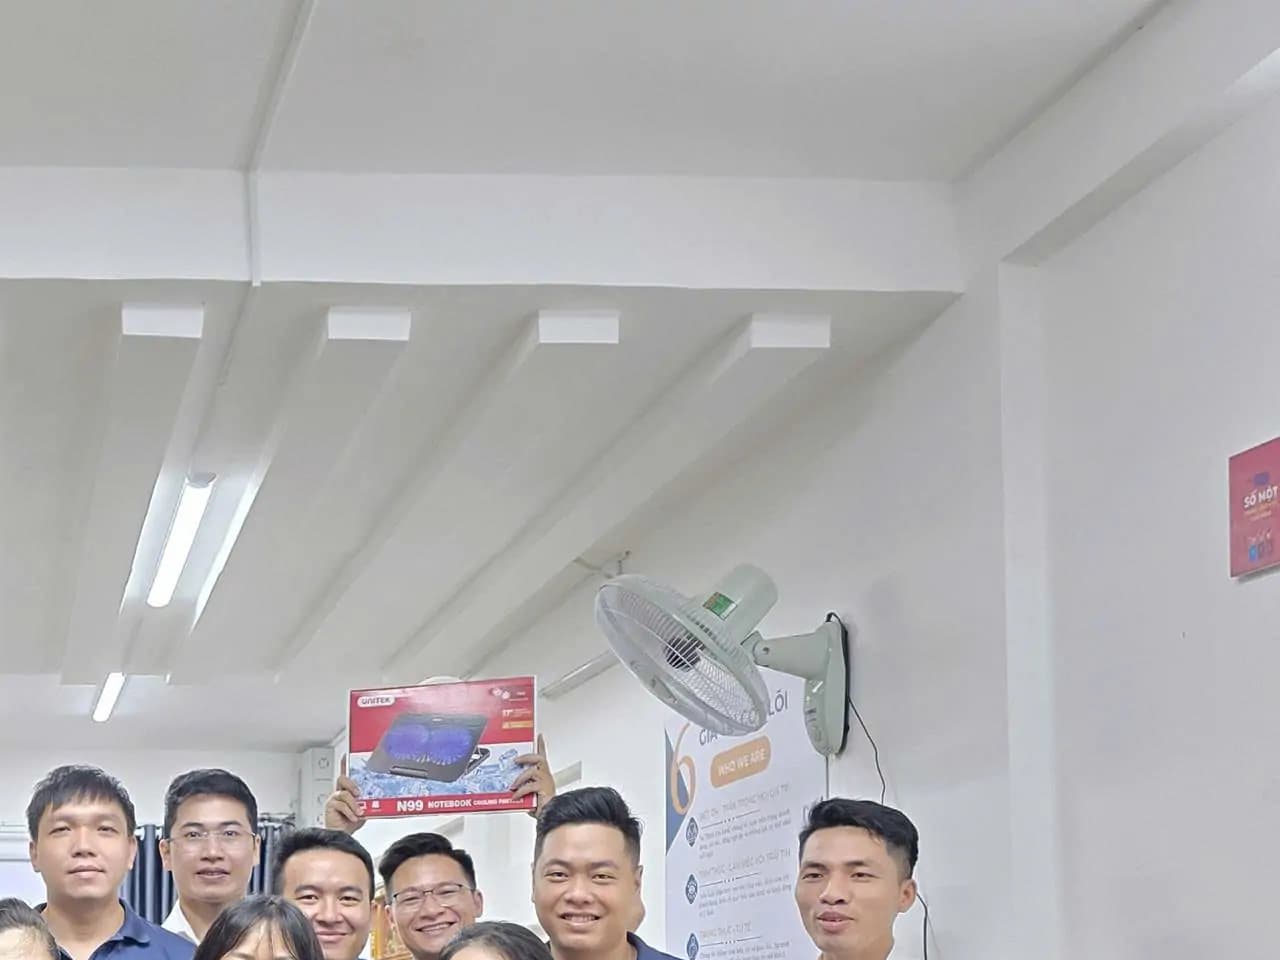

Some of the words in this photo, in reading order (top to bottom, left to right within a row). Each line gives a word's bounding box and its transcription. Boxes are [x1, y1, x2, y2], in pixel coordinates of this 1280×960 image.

[717, 760, 737, 777] WHO
[736, 754, 751, 769] WE
[750, 747, 767, 765] ARE
[396, 799, 424, 812] N99
[428, 799, 472, 809] NOTEBOOK
